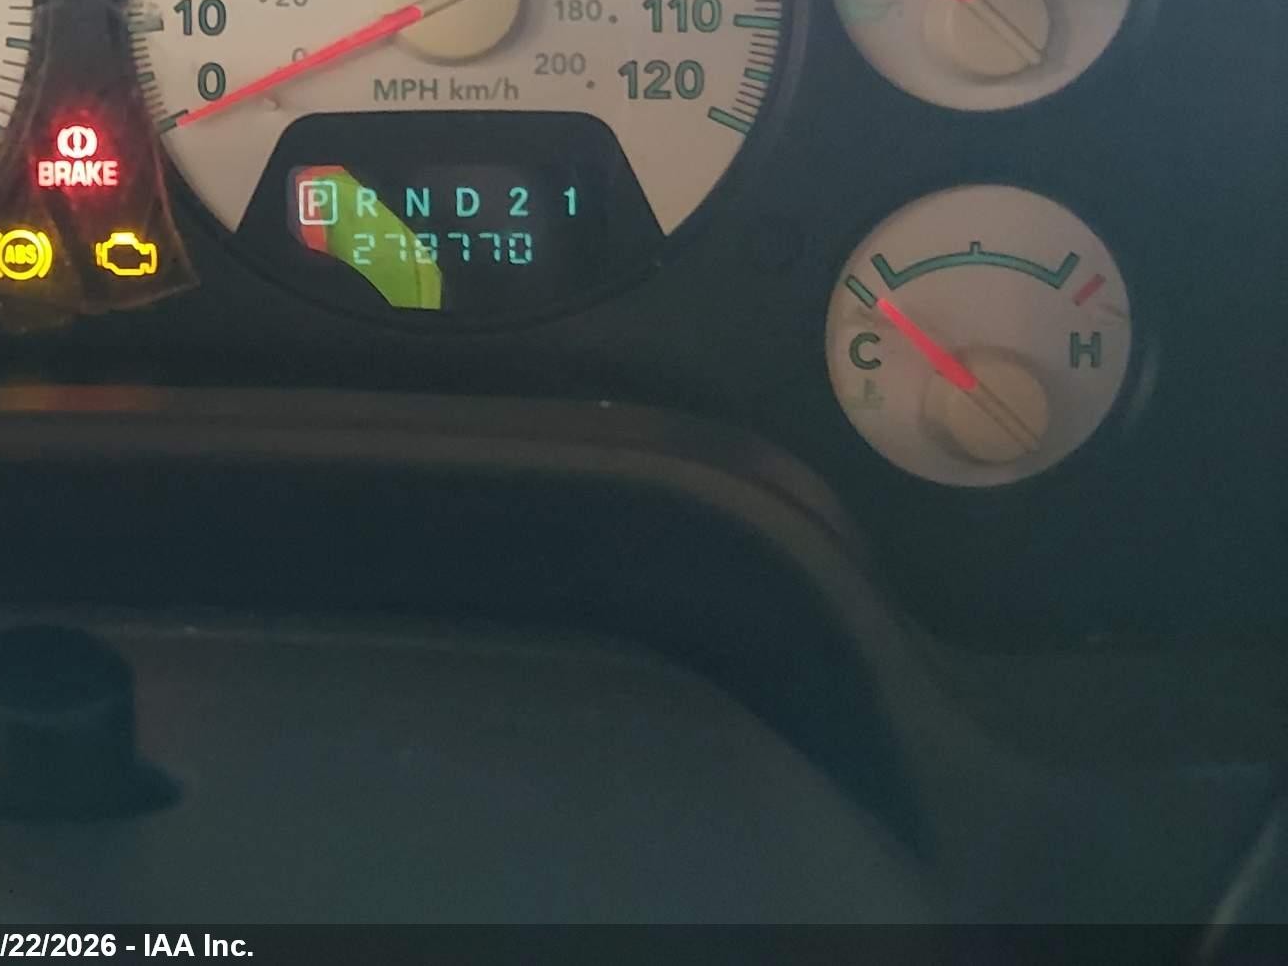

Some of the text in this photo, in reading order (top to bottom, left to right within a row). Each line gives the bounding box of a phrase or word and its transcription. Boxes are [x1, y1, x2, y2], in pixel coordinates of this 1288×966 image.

[555, 0, 602, 21] 180
[535, 53, 585, 75] 200
[198, 62, 226, 101] 0
[373, 78, 519, 101] MPH km/h
[618, 60, 704, 99] 120
[38, 161, 118, 186] BRAKE
[307, 186, 576, 217] P R N D 2 1
[5, 244, 37, 264] ABS
[849, 334, 881, 370] C
[1070, 332, 1101, 367] H
